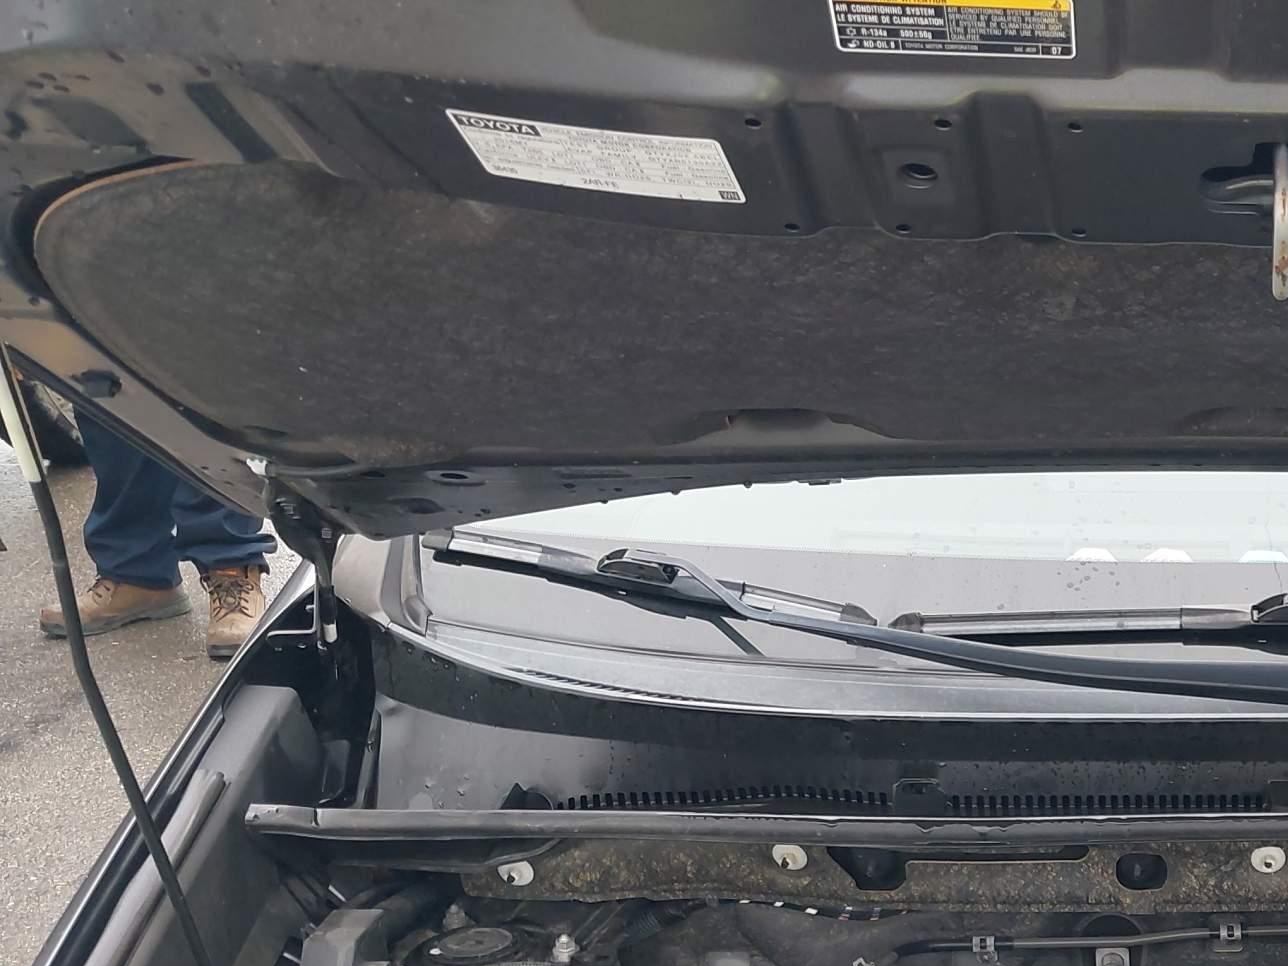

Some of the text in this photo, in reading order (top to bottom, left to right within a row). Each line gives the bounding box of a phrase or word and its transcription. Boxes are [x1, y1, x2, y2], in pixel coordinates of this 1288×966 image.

[835, 3, 936, 16] AIR CONDITIONING SYSTEM
[836, 13, 846, 22] LE
[881, 15, 891, 24] DE
[892, 16, 944, 26] CLIMATISATION
[861, 27, 888, 37] R-134a
[1051, 47, 1062, 55] 07
[459, 116, 535, 136] TOYOTA
